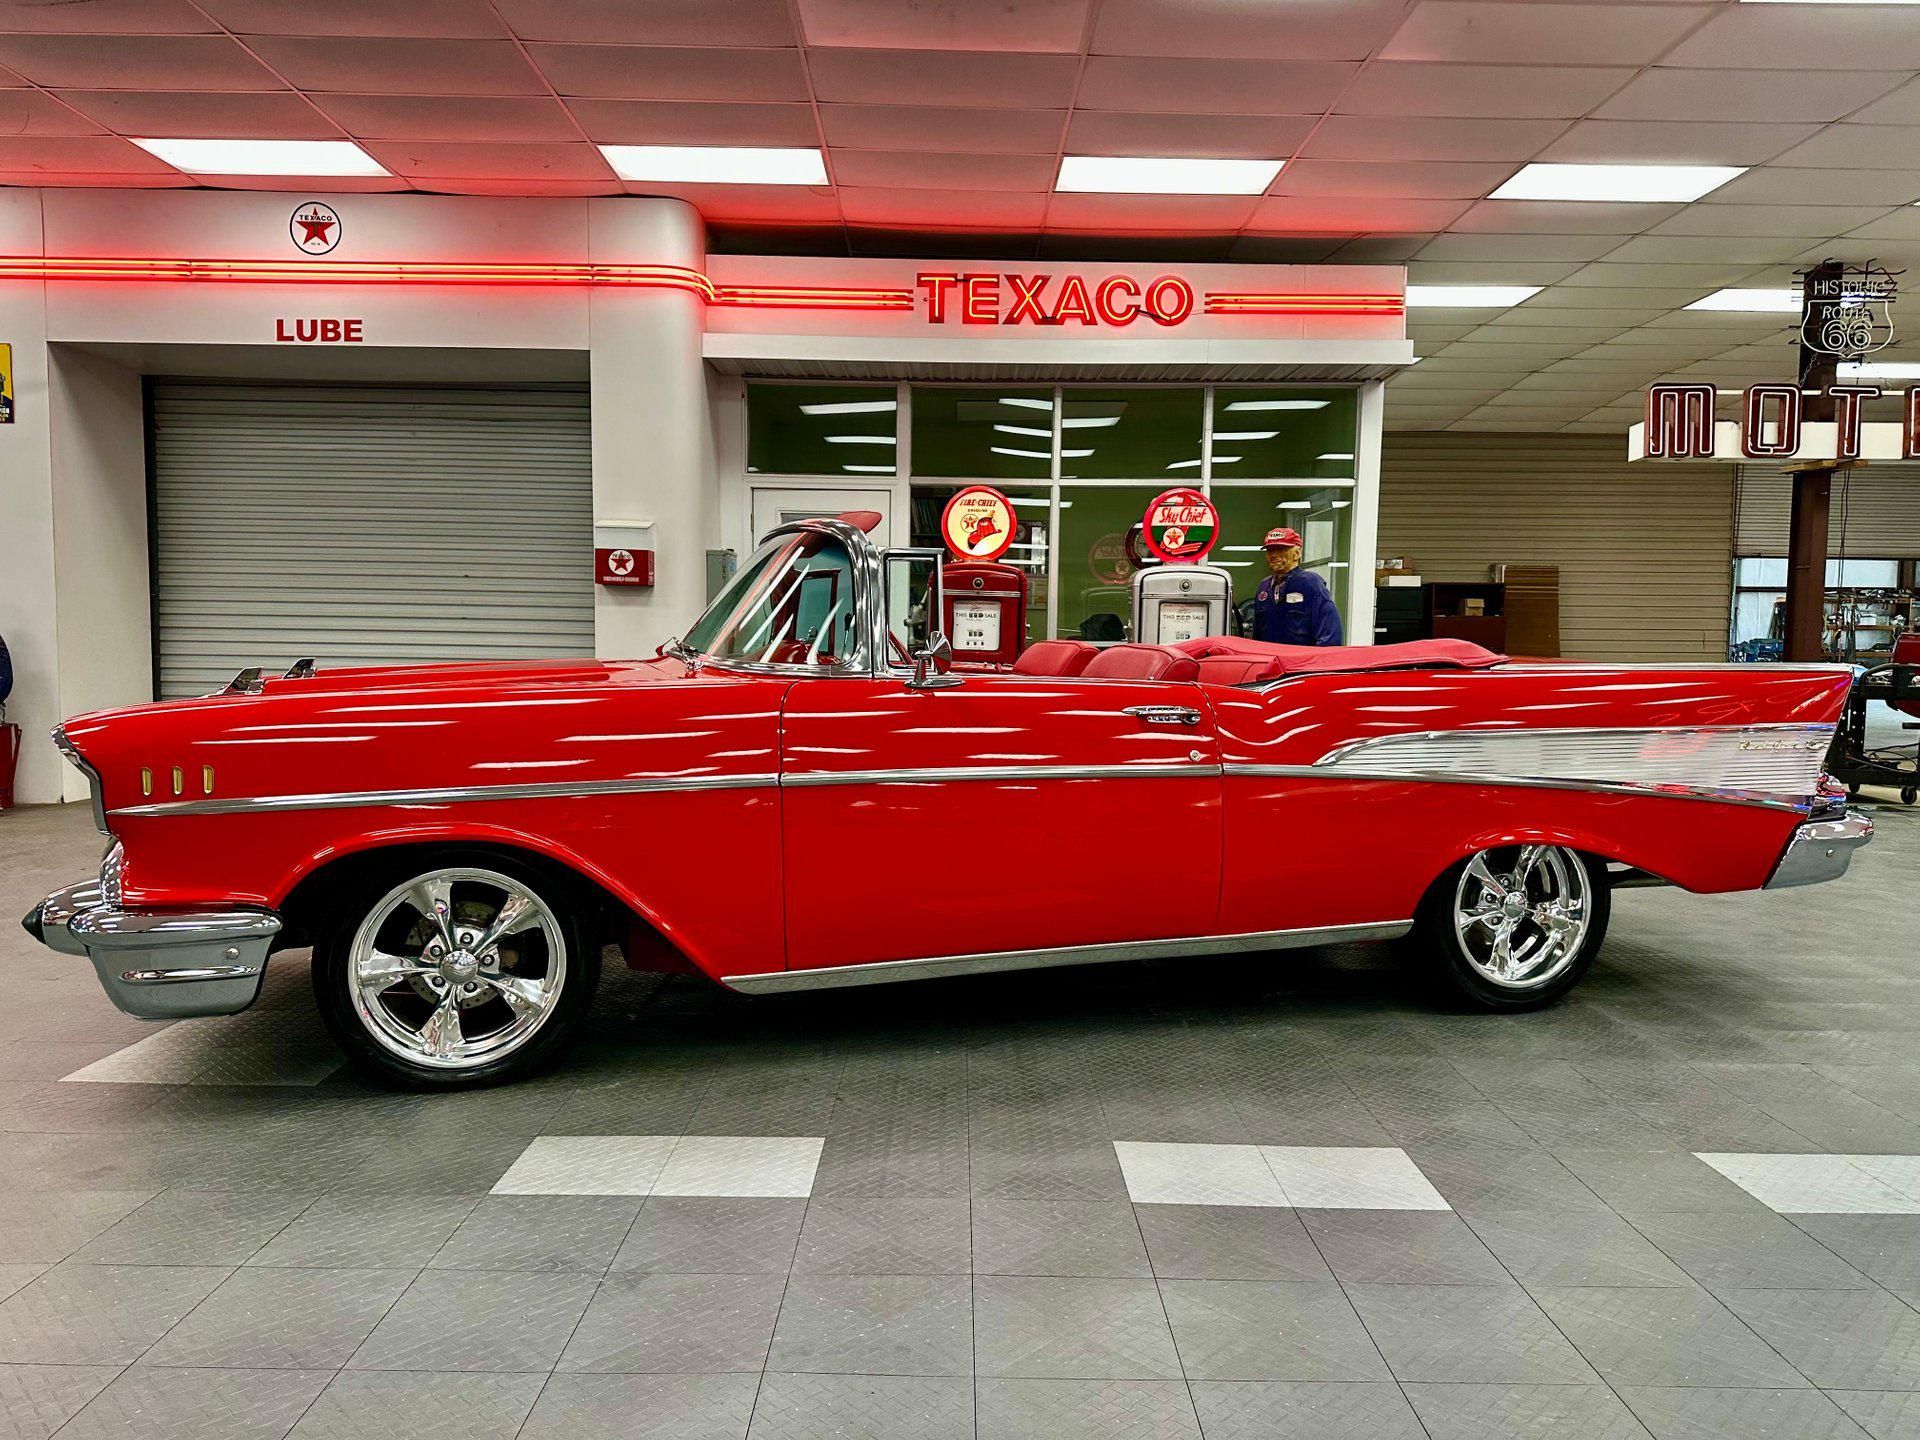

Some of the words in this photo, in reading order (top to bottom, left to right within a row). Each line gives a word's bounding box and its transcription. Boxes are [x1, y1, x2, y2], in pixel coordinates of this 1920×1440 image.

[299, 214, 333, 222] TEXACO
[1814, 279, 1886, 296] HISTORIC
[916, 272, 1195, 327] TEXACO
[1821, 305, 1872, 321] ROUTE
[276, 319, 363, 342] LUBE
[1821, 319, 1873, 351] 66
[1644, 382, 1920, 460] MOT
[959, 498, 998, 507] FIRE-CHIEF
[1159, 507, 1179, 525] Sky
[1180, 506, 1207, 523] Chief
